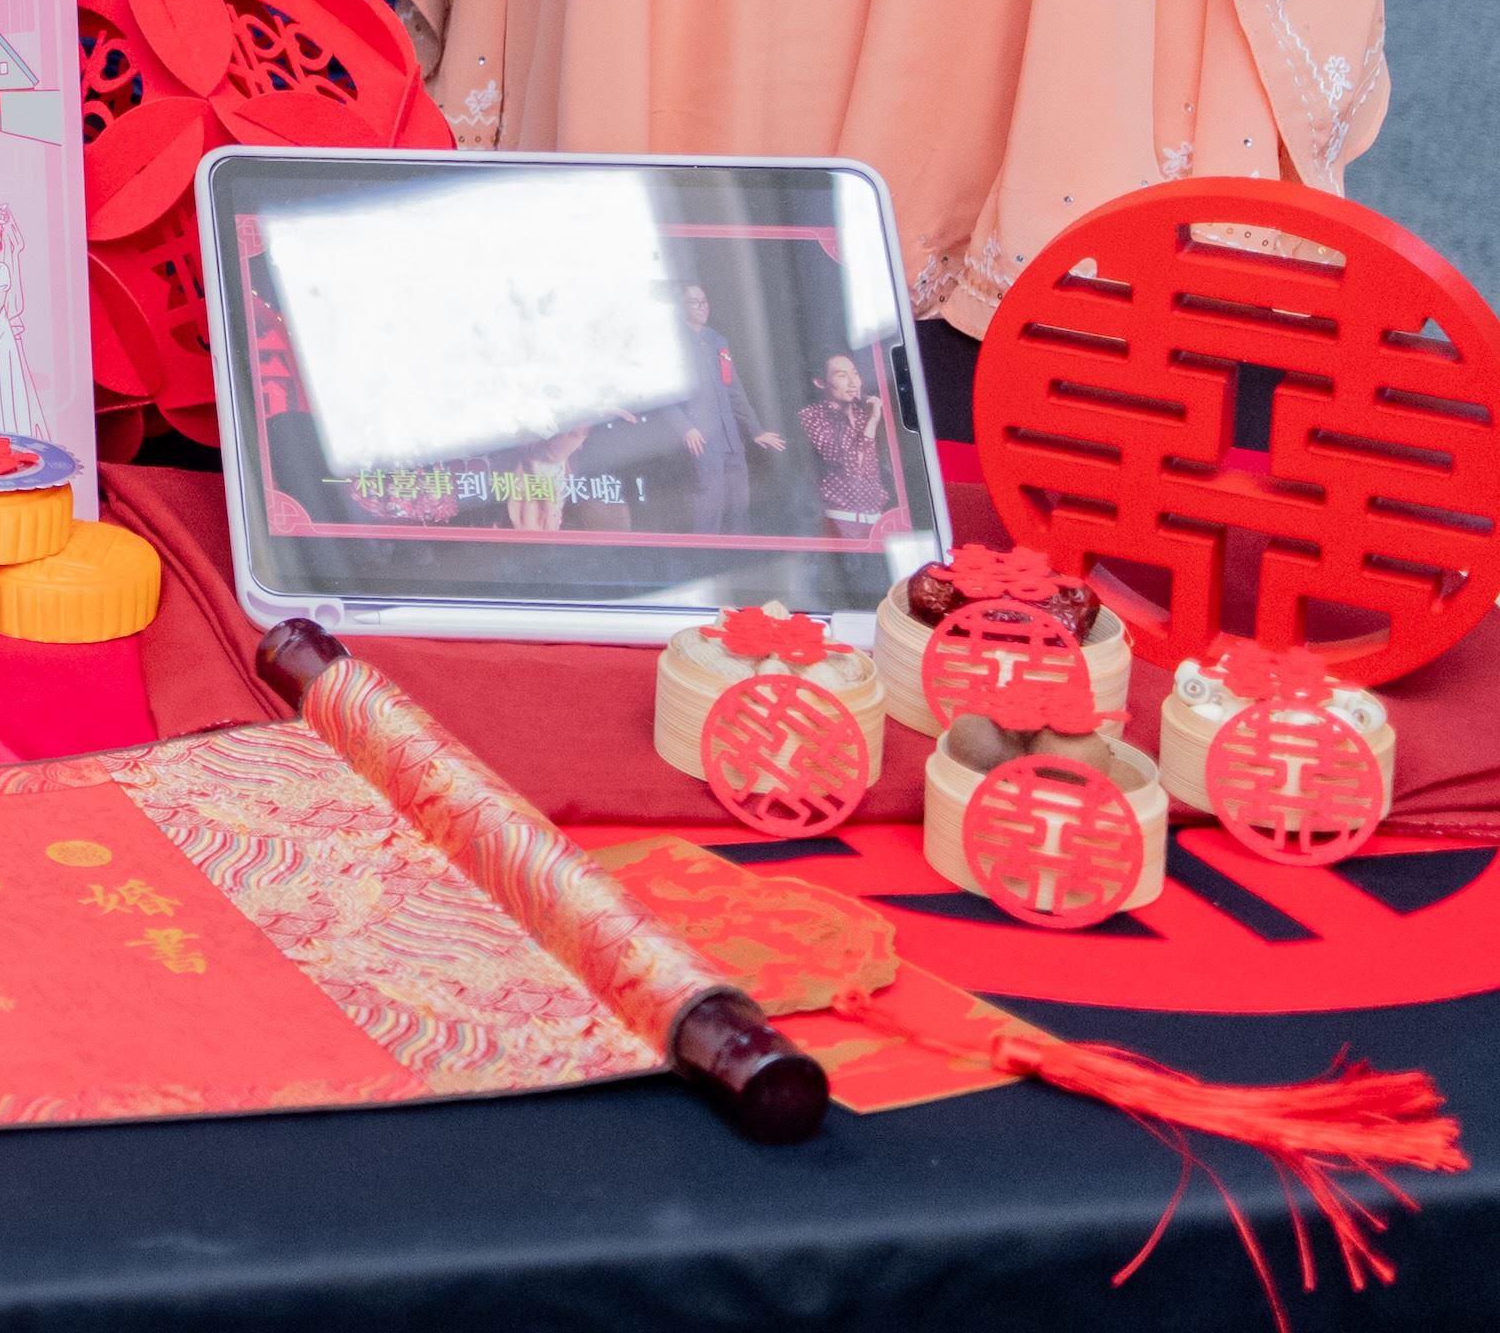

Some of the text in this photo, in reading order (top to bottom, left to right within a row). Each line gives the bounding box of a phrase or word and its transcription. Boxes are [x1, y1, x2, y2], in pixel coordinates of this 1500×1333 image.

[322, 467, 647, 505] 一村喜事到桃園來啦！
